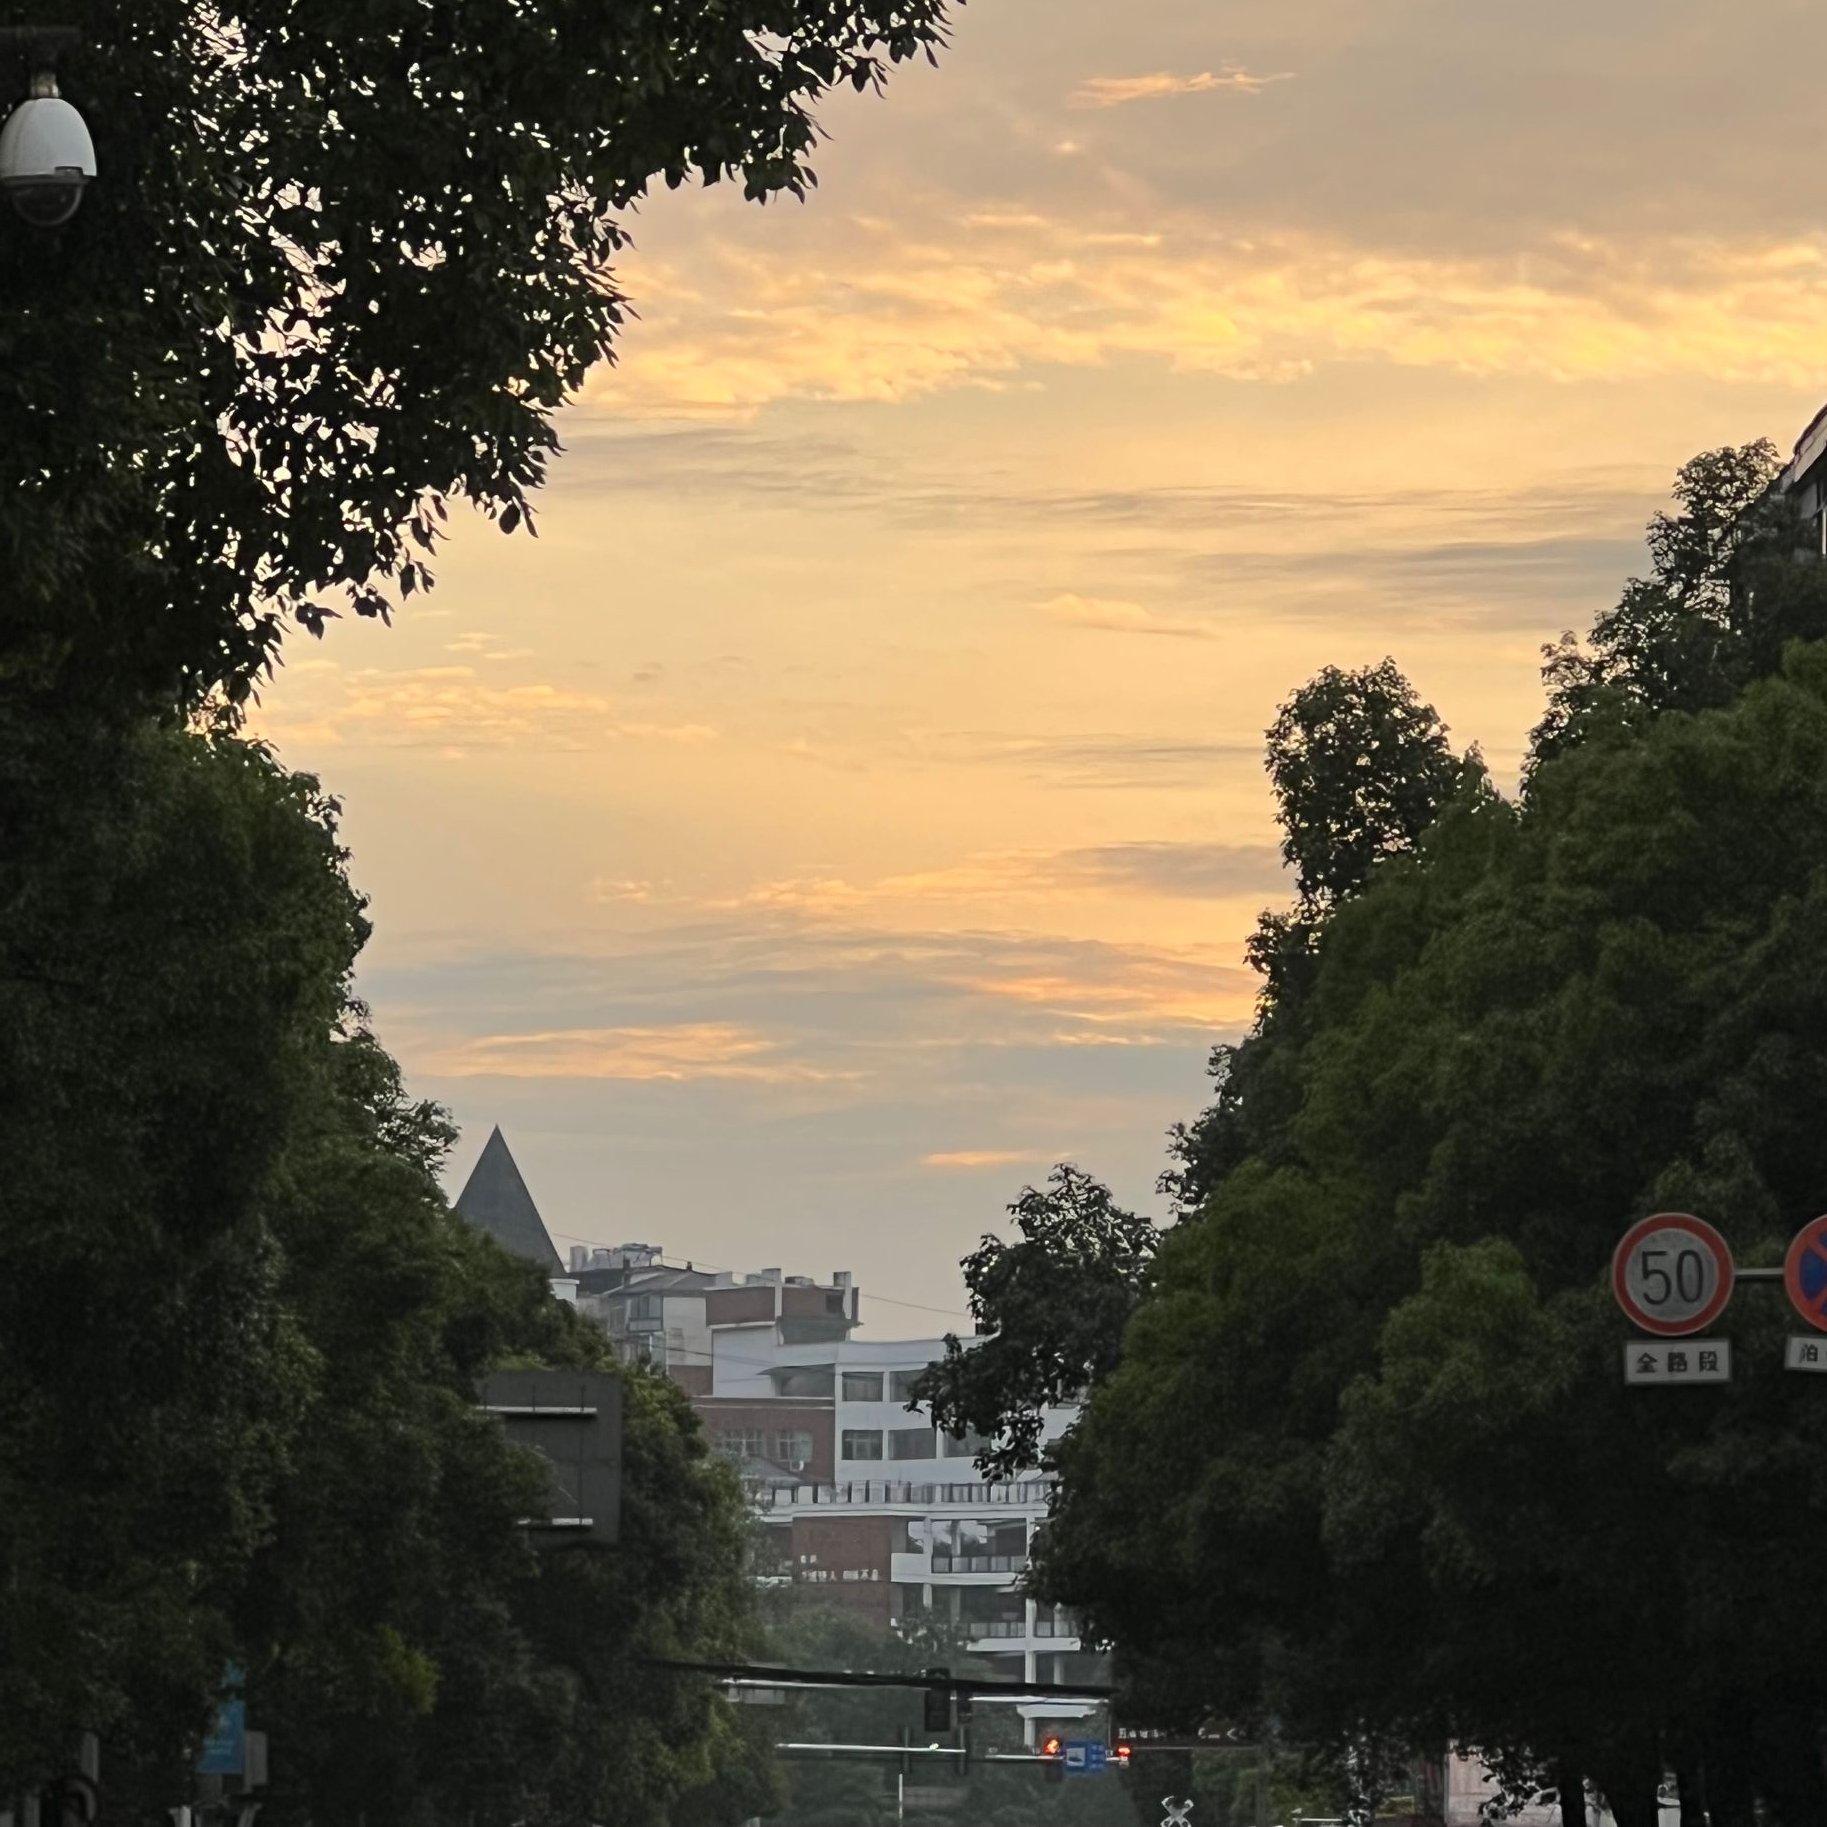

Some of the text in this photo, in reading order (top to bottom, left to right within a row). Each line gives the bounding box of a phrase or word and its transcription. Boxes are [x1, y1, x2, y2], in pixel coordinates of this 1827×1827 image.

[1641, 1250, 1703, 1305] 50
[1636, 1351, 1719, 1374] 全路段
